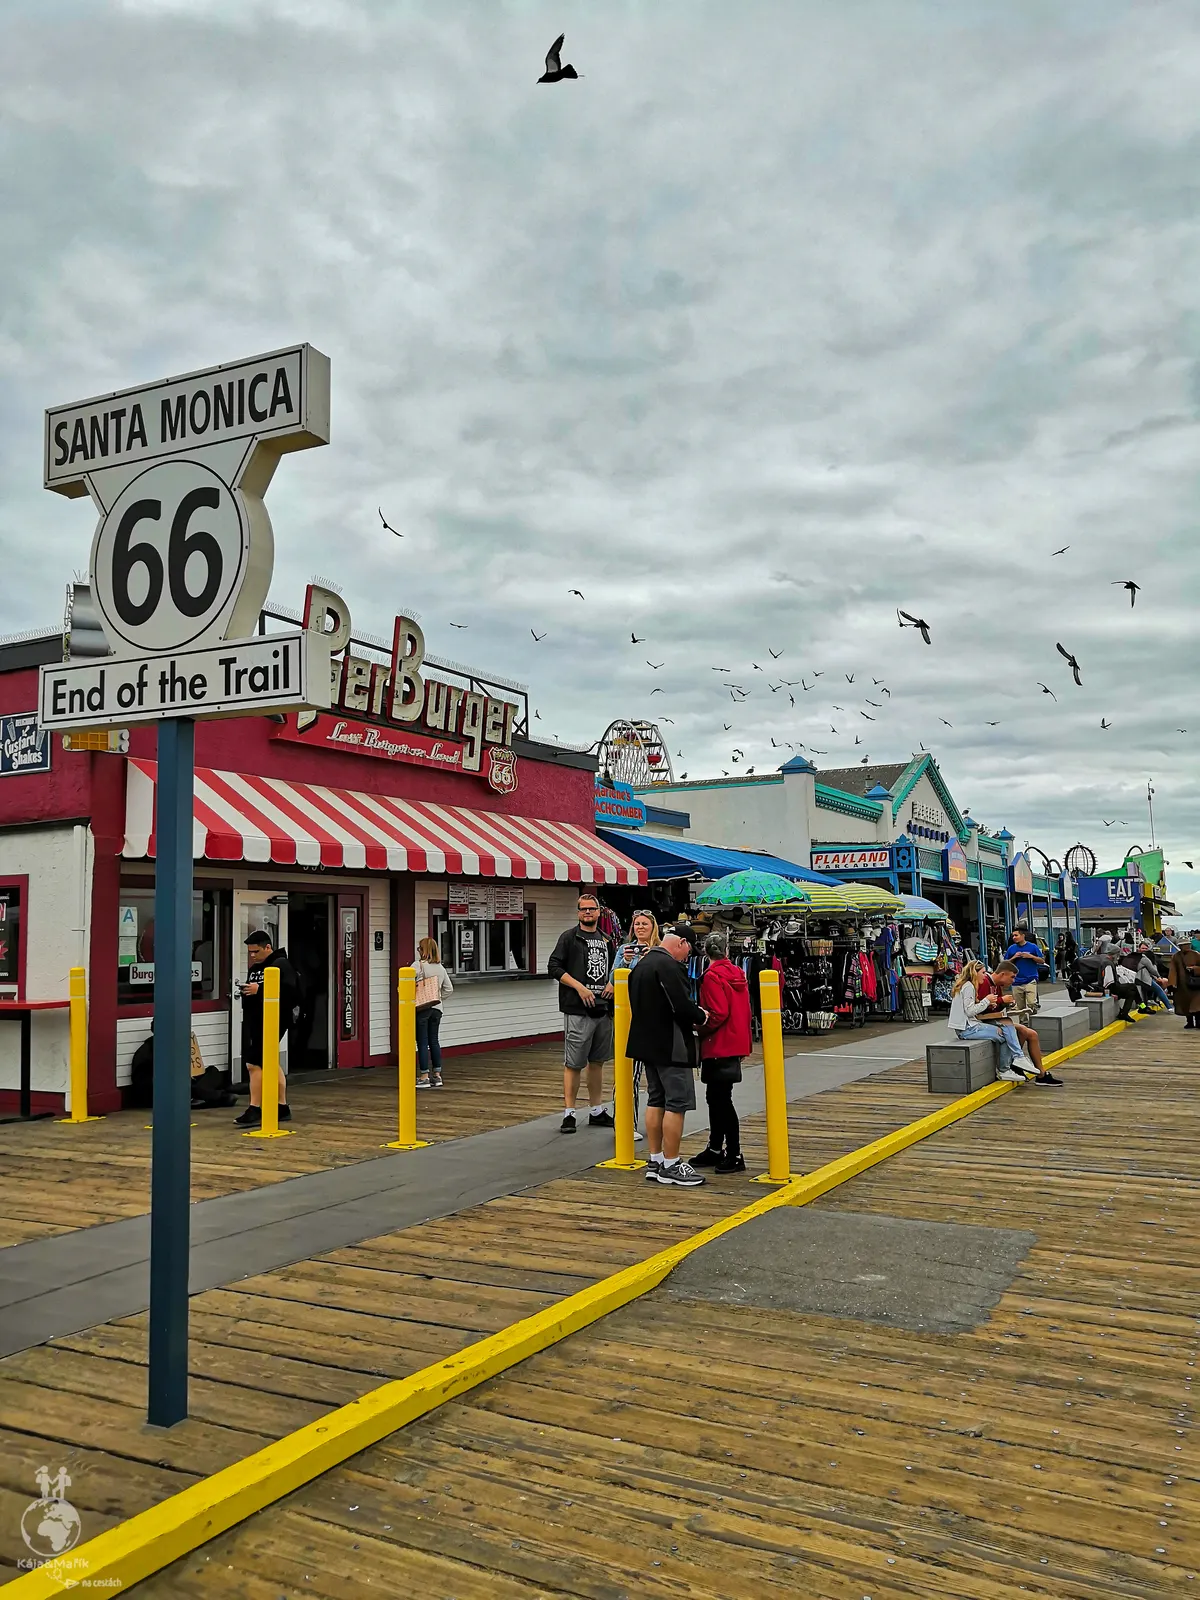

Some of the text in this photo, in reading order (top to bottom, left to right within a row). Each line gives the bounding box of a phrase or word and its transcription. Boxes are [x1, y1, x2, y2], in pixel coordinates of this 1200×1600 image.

[54, 367, 294, 467] SANTA MONICA
[111, 486, 223, 626] 66
[52, 644, 290, 716] End of the Trail
[4, 731, 36, 758] Custard
[12, 749, 43, 769] Shakes
[491, 764, 513, 785] 66
[814, 851, 888, 865] PLAYLAND
[1107, 878, 1134, 898] EAT
[122, 908, 135, 923] A
